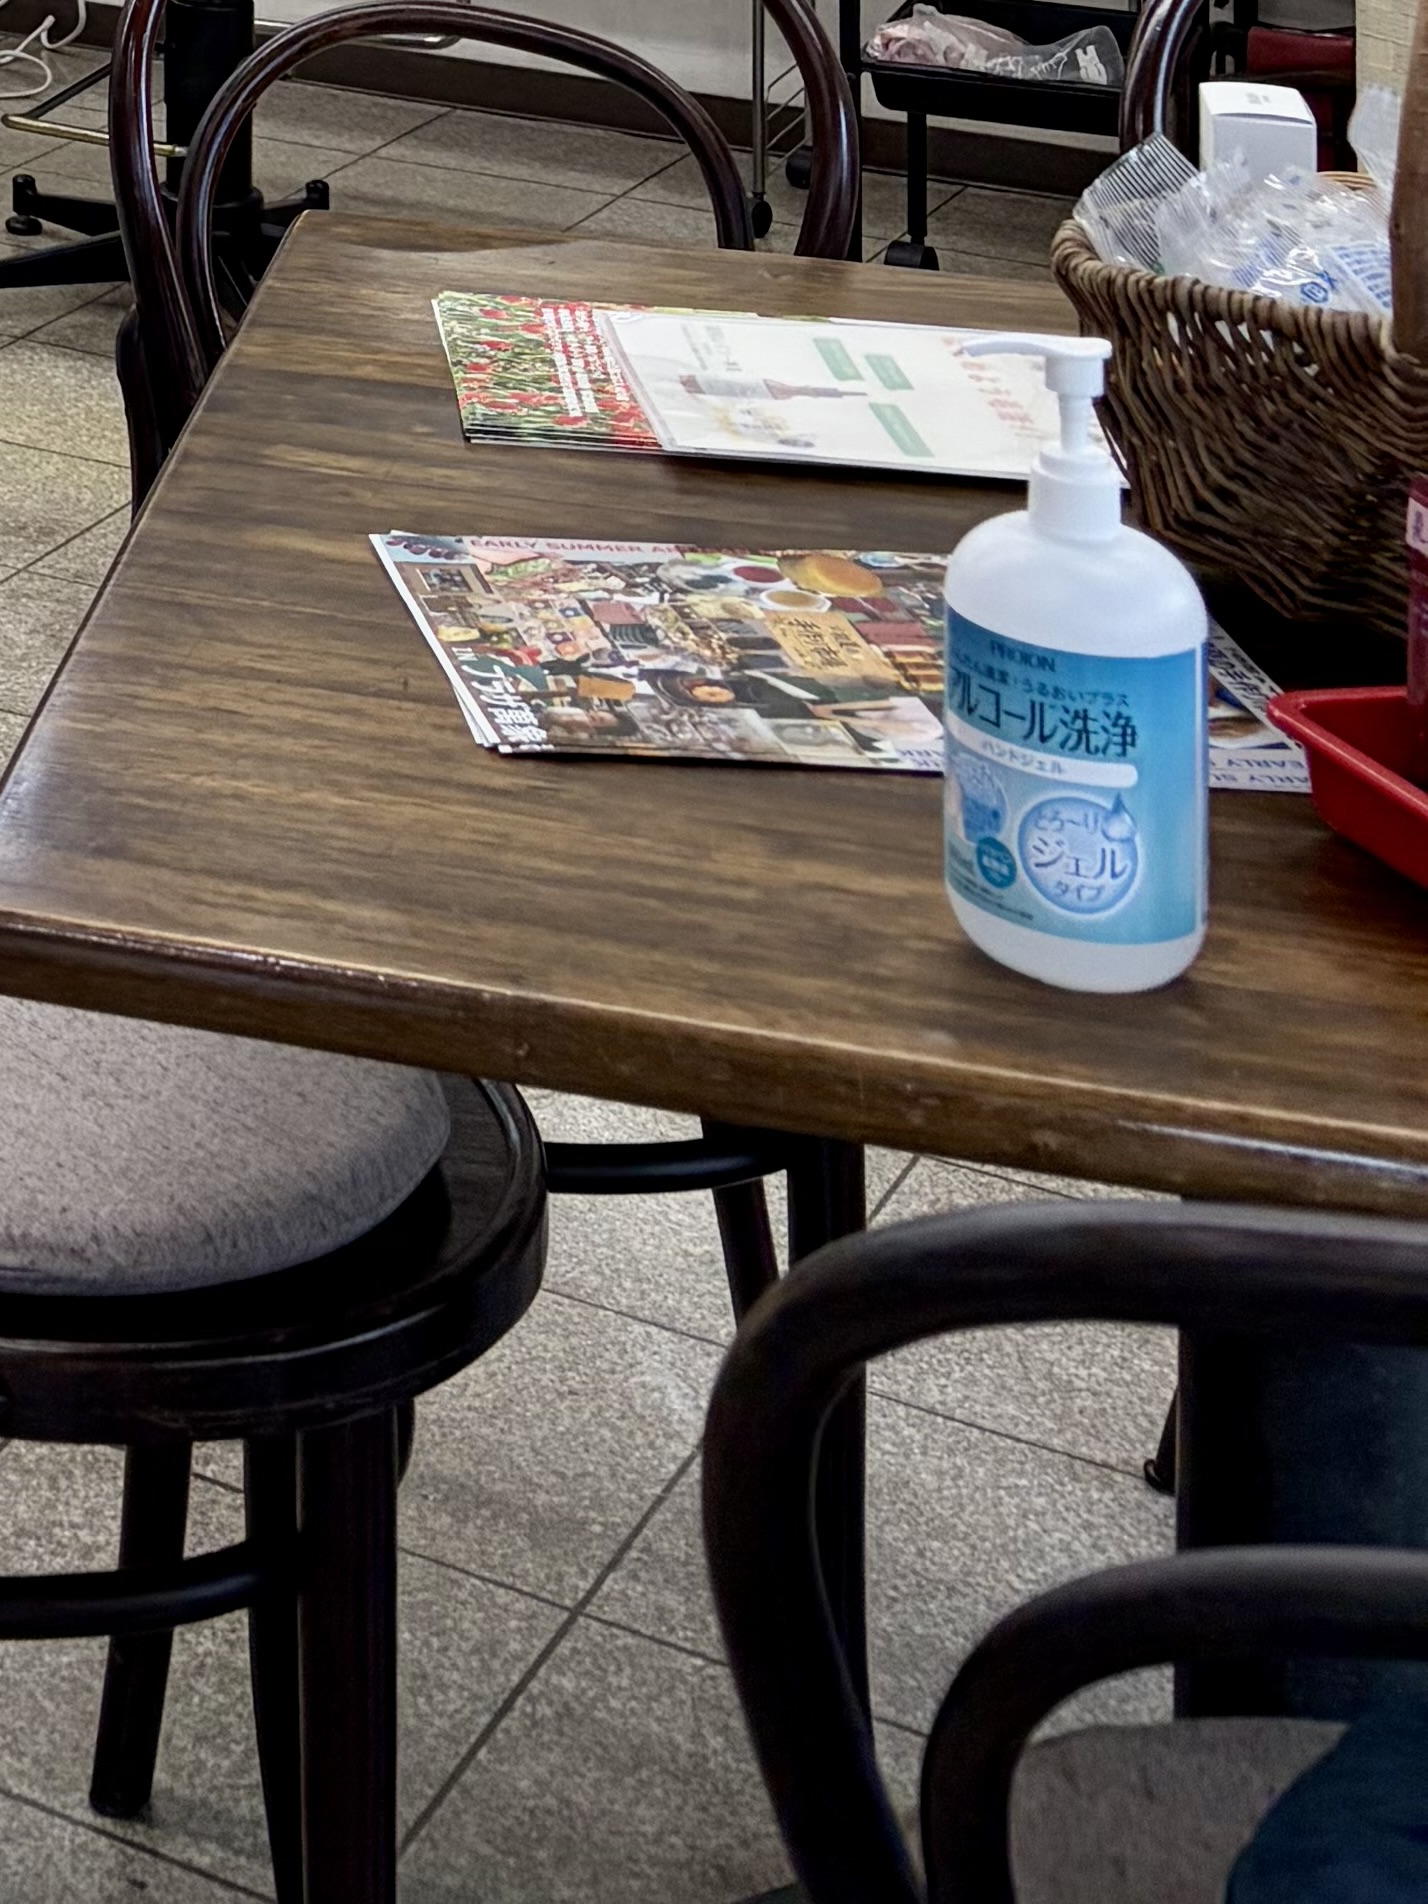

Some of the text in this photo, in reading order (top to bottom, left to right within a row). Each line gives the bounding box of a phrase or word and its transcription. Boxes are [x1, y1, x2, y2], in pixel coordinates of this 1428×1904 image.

[1031, 835, 1129, 880] ジェル
[1054, 879, 1106, 903] タイプ
